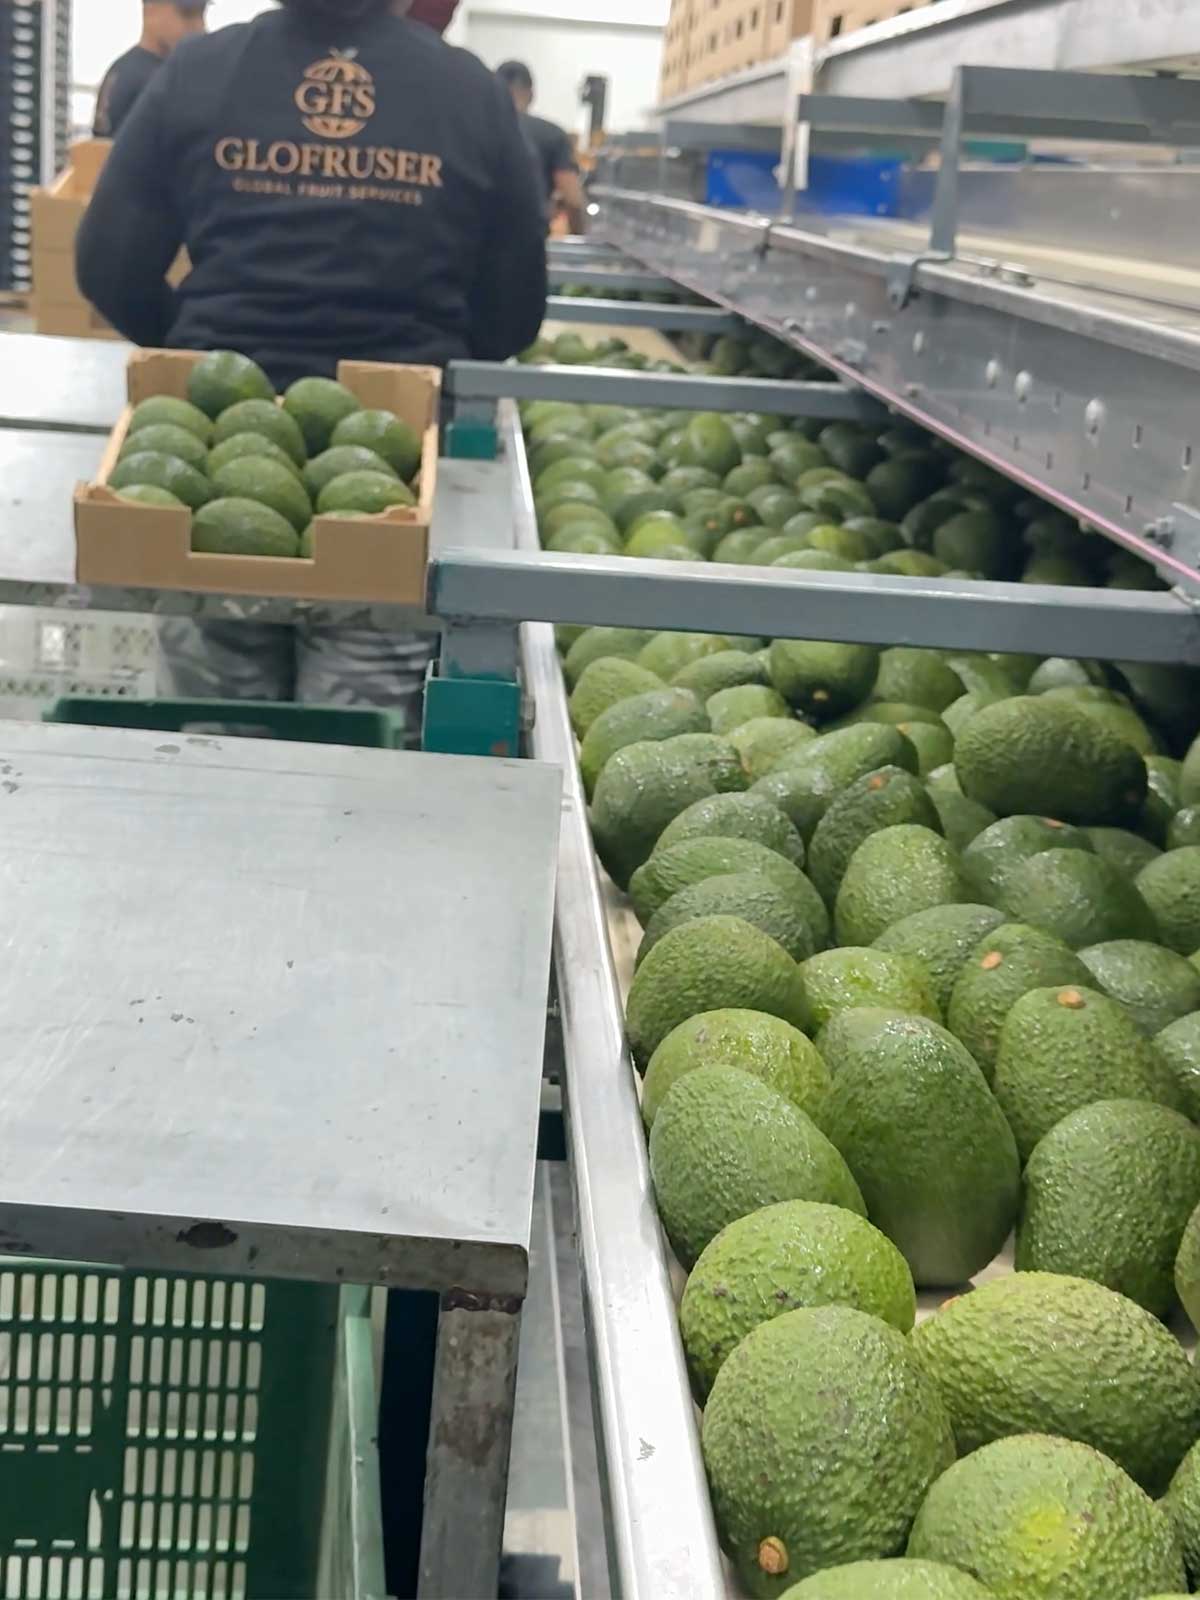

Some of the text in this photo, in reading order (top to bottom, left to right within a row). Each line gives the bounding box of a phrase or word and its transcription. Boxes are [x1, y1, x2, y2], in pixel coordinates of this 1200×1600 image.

[294, 80, 376, 118] GFS
[214, 137, 443, 187] GLOFRUSER
[232, 177, 291, 195] GLOBAL
